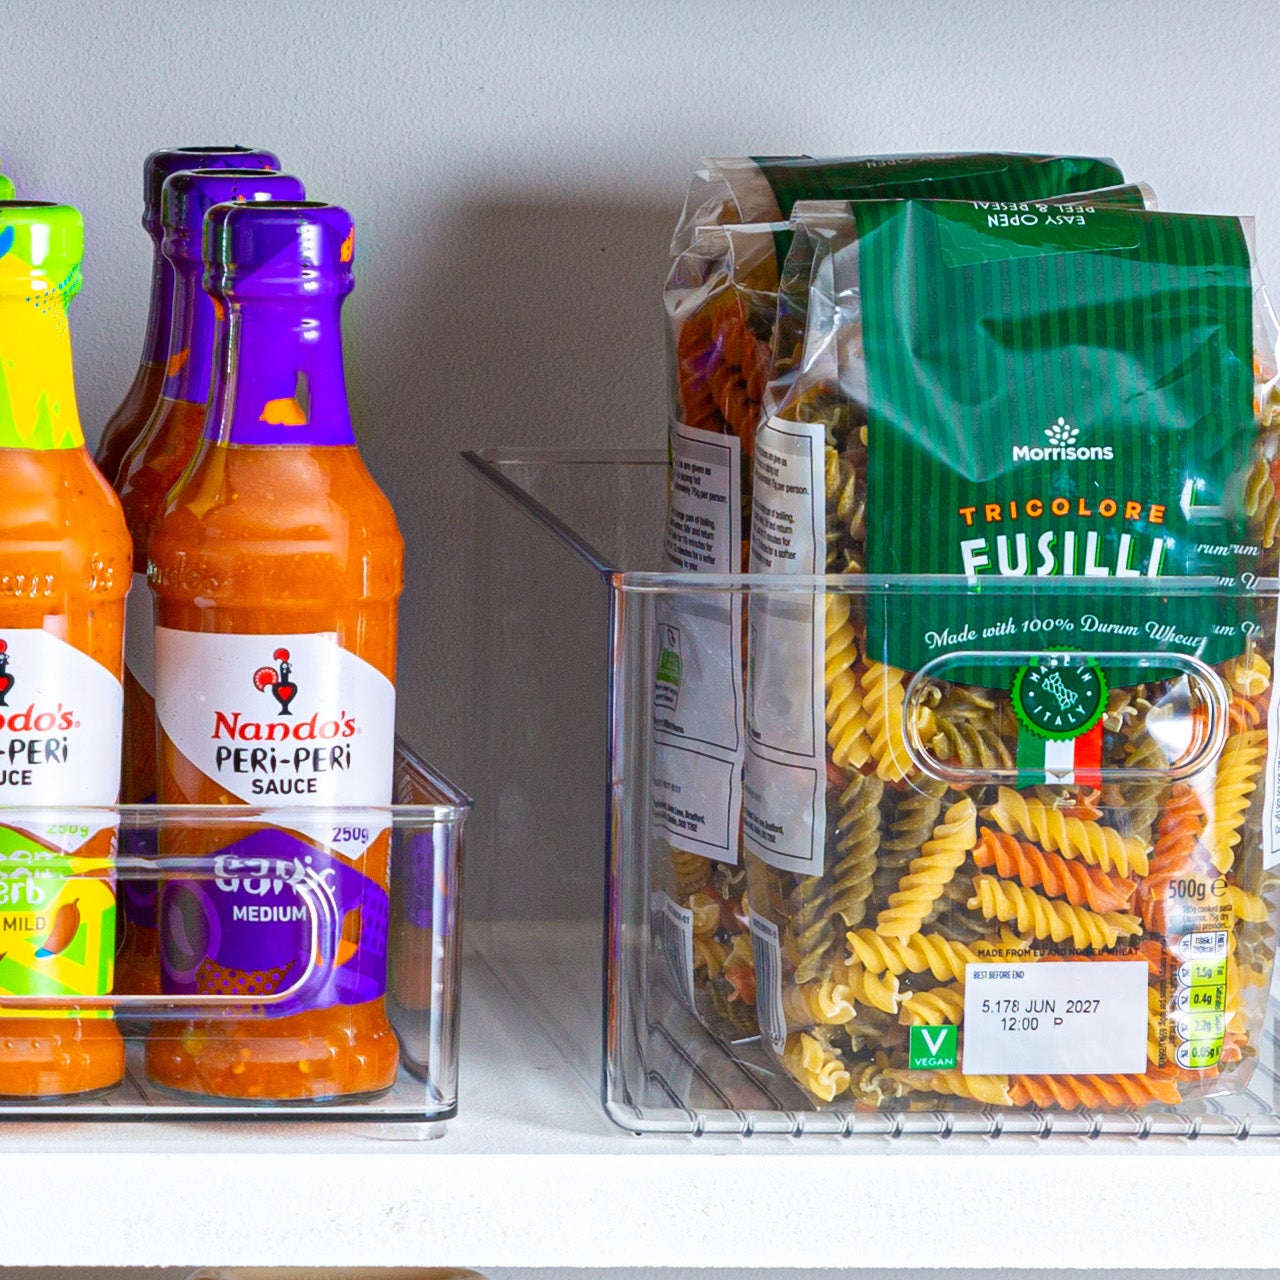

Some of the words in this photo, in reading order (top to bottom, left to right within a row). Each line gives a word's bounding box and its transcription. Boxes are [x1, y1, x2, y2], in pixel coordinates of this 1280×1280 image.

[987, 214, 1038, 228] OPEN
[1012, 444, 1113, 462] Morrisons
[959, 498, 1165, 526] TRICOLORE
[960, 532, 1170, 582] FUSILLI
[1169, 879, 1206, 900] 500g
[232, 905, 306, 922] MEDIUM
[4, 916, 47, 932] MILD
[982, 1000, 1019, 1013] 5.178
[1025, 1000, 1055, 1013] JUN
[1066, 1000, 1100, 1013] 2027
[1002, 1018, 1038, 1031] 12:00
[914, 1056, 954, 1067] VEGAN
